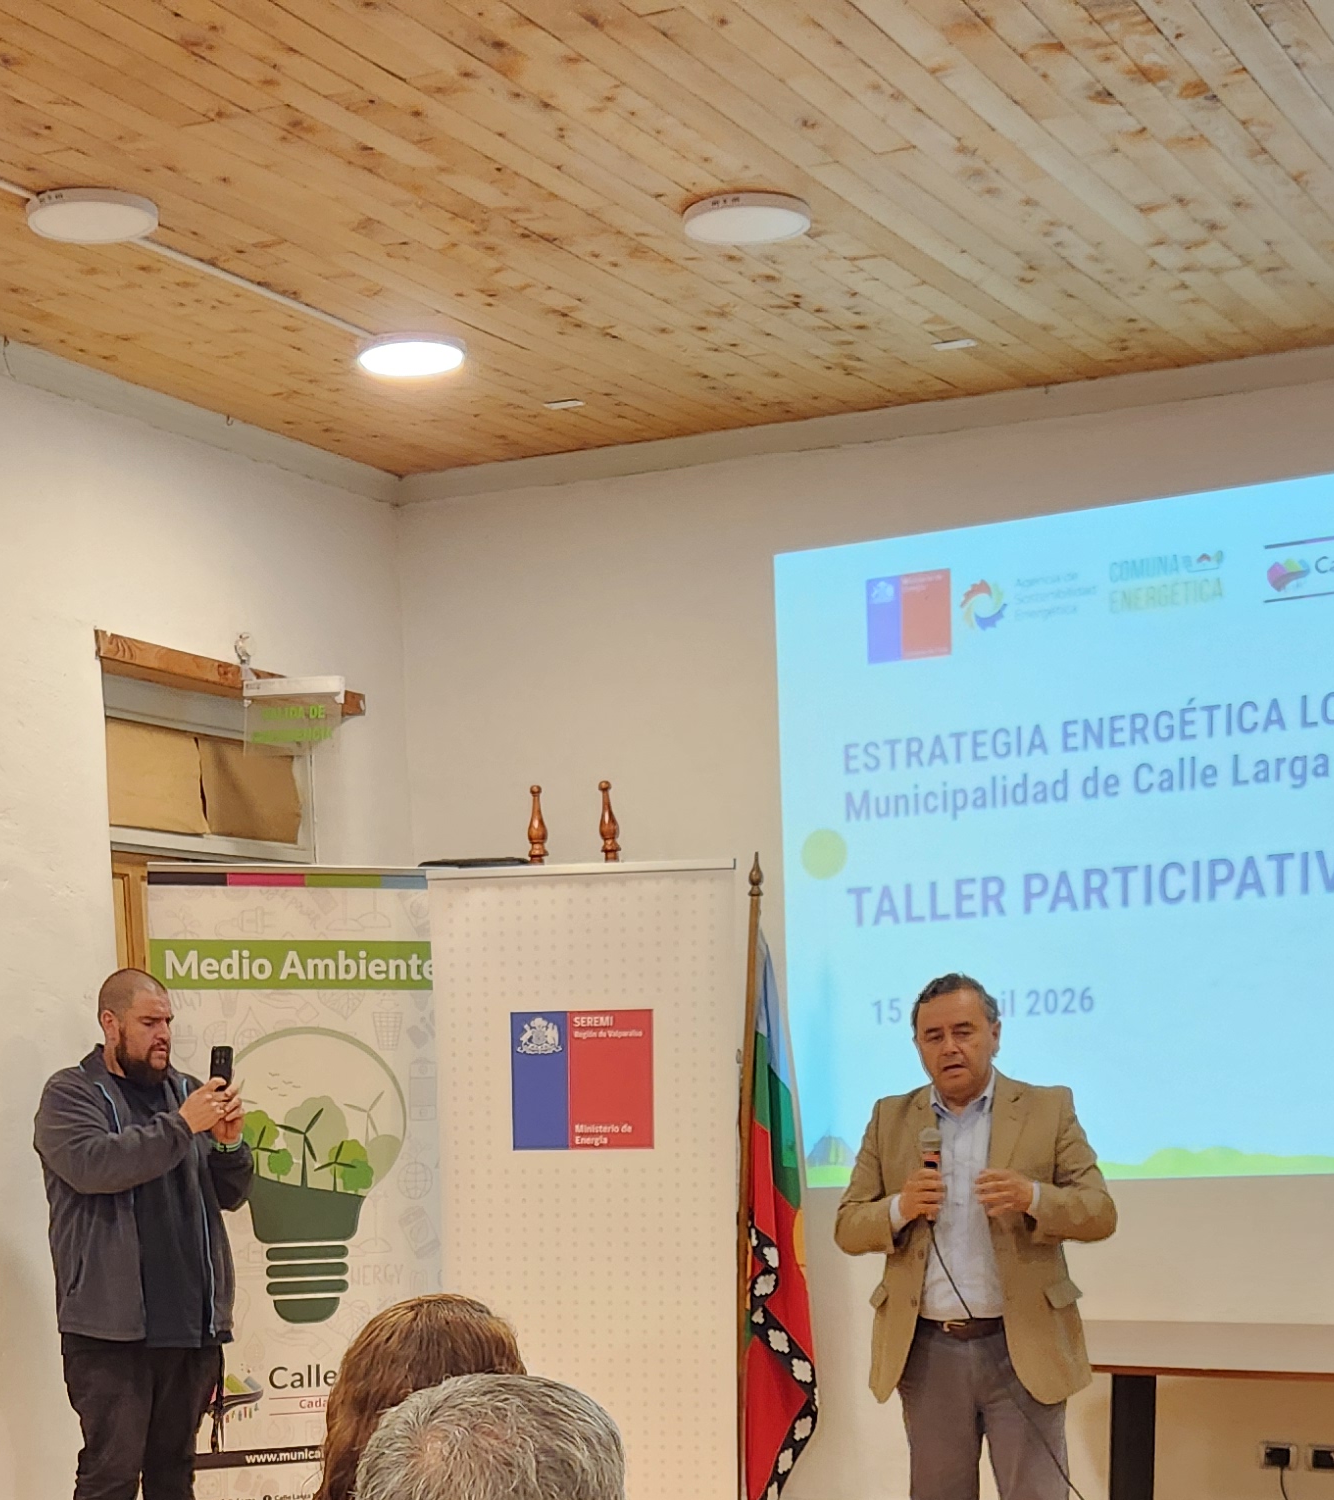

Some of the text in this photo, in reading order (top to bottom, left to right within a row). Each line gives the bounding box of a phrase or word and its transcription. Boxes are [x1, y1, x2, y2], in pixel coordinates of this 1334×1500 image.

[1109, 554, 1180, 583] COMUNA
[309, 704, 326, 719] DE
[843, 723, 1049, 775] ESTRATEGIA
[1061, 697, 1287, 753] ENERGÉTICA
[845, 752, 1330, 822] Municipalidad de Calle Larga
[846, 875, 1007, 928] TALLER
[164, 949, 272, 981] Medio
[870, 997, 903, 1026] 15
[1025, 987, 1095, 1017] 2026
[572, 1015, 614, 1028] SEREMI
[574, 1123, 633, 1134] Ministerio de
[574, 1136, 609, 1147] Energía
[268, 1364, 338, 1390] Calle
